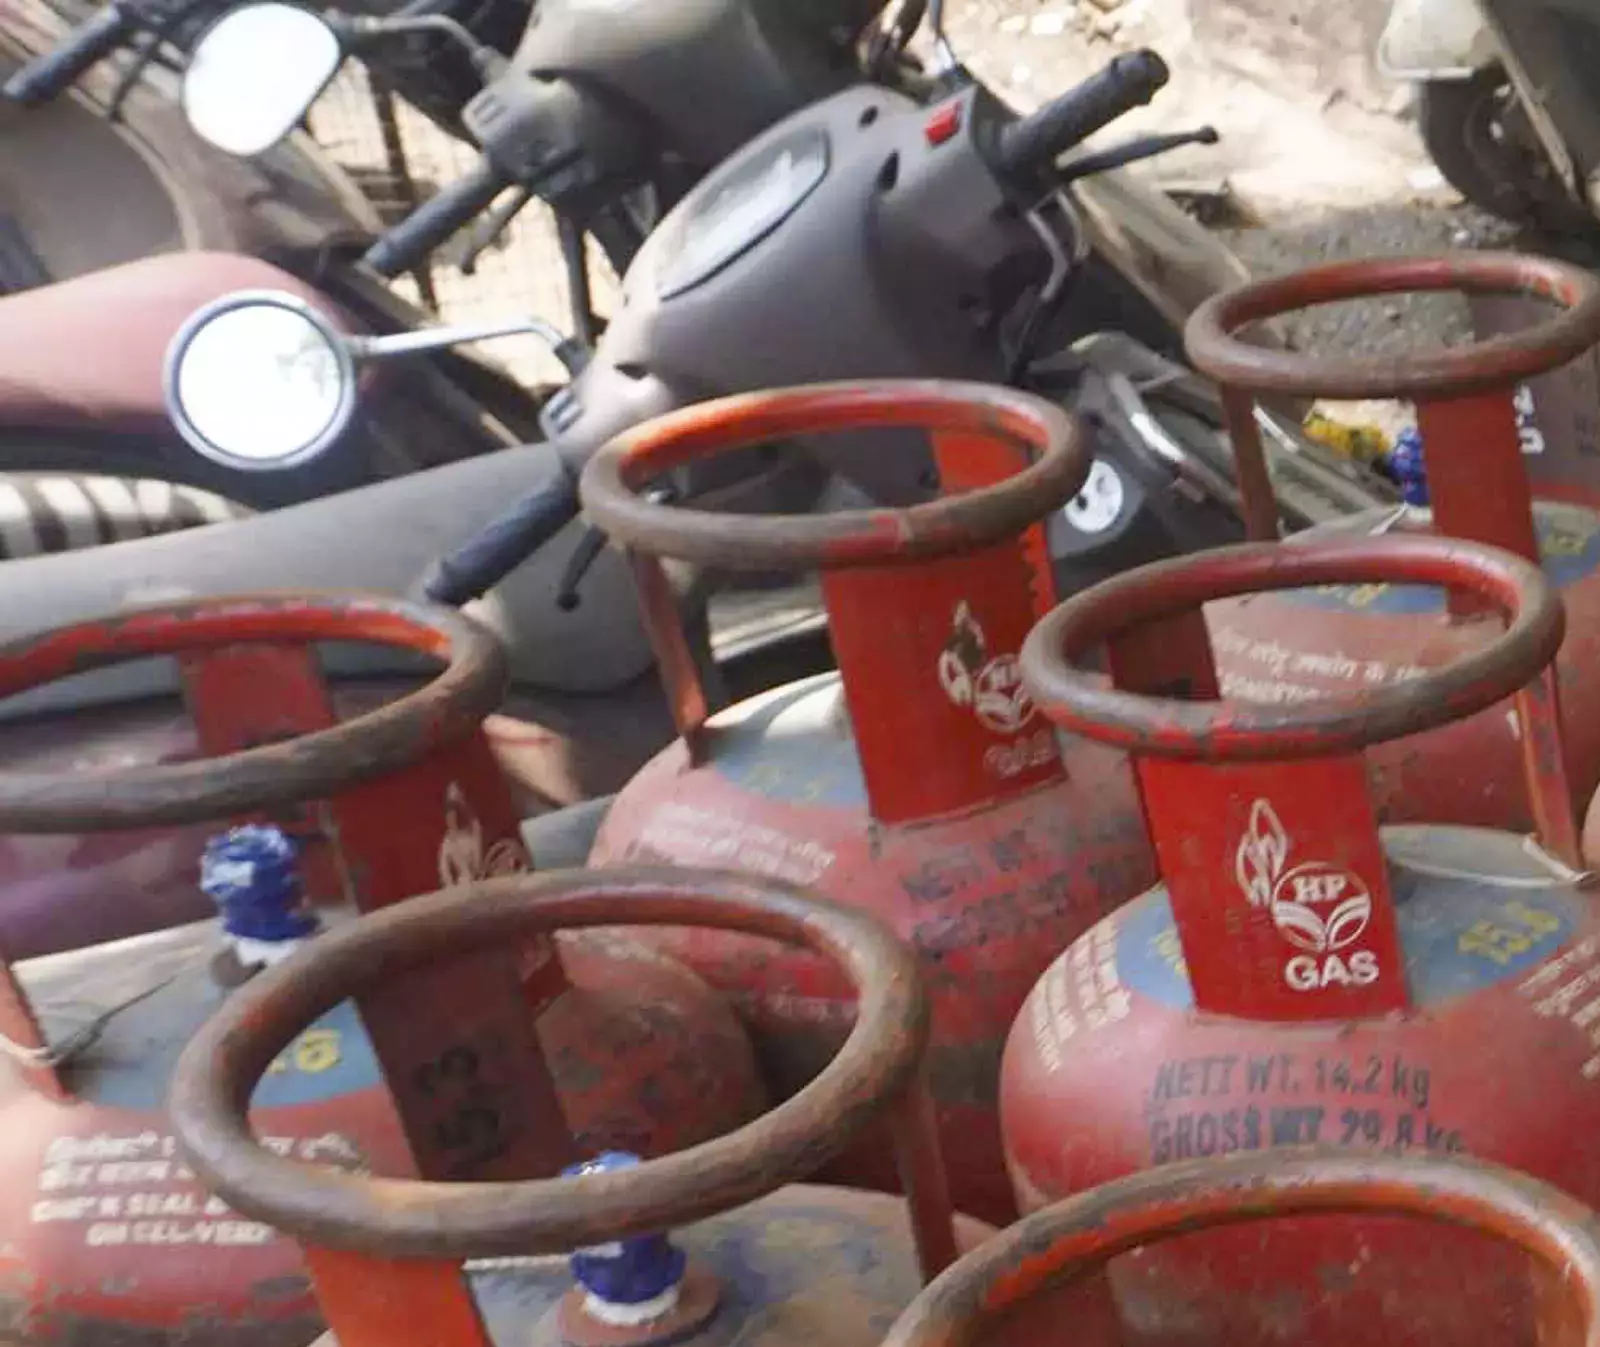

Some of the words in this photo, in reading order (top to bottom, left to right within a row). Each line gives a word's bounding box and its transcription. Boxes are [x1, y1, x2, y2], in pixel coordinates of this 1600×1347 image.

[1296, 875, 1347, 903] HP
[1285, 951, 1380, 991] GAS
[1152, 1052, 1240, 1100] NETT
[1315, 1053, 1385, 1095] 14.2
[1392, 1052, 1431, 1110] kg
[1151, 1104, 1261, 1163] GROSS
